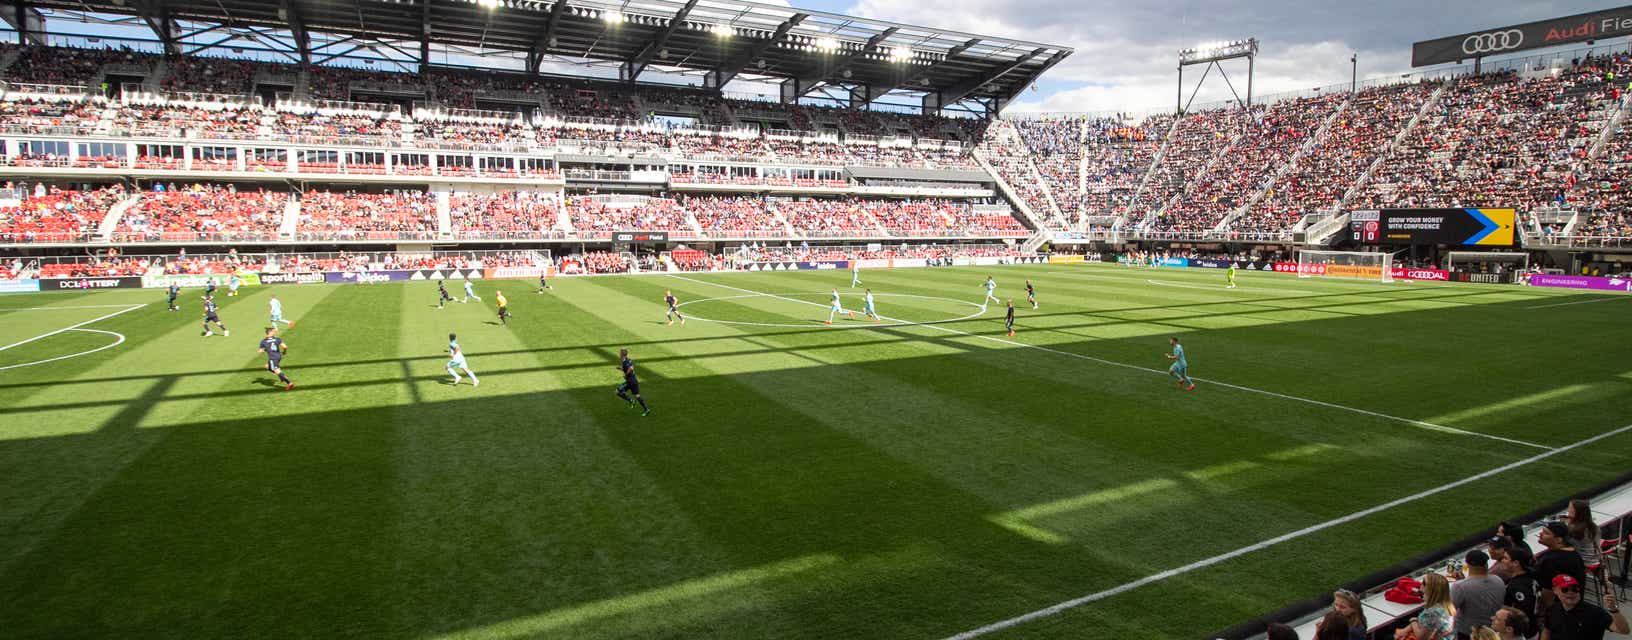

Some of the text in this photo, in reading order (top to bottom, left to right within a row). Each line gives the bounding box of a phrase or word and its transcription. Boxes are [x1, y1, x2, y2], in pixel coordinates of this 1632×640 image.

[1544, 21, 1596, 41] Audi
[261, 272, 325, 284] sport&health
[1470, 273, 1499, 283] UNITED
[1541, 278, 1588, 286] ENGINEERING
